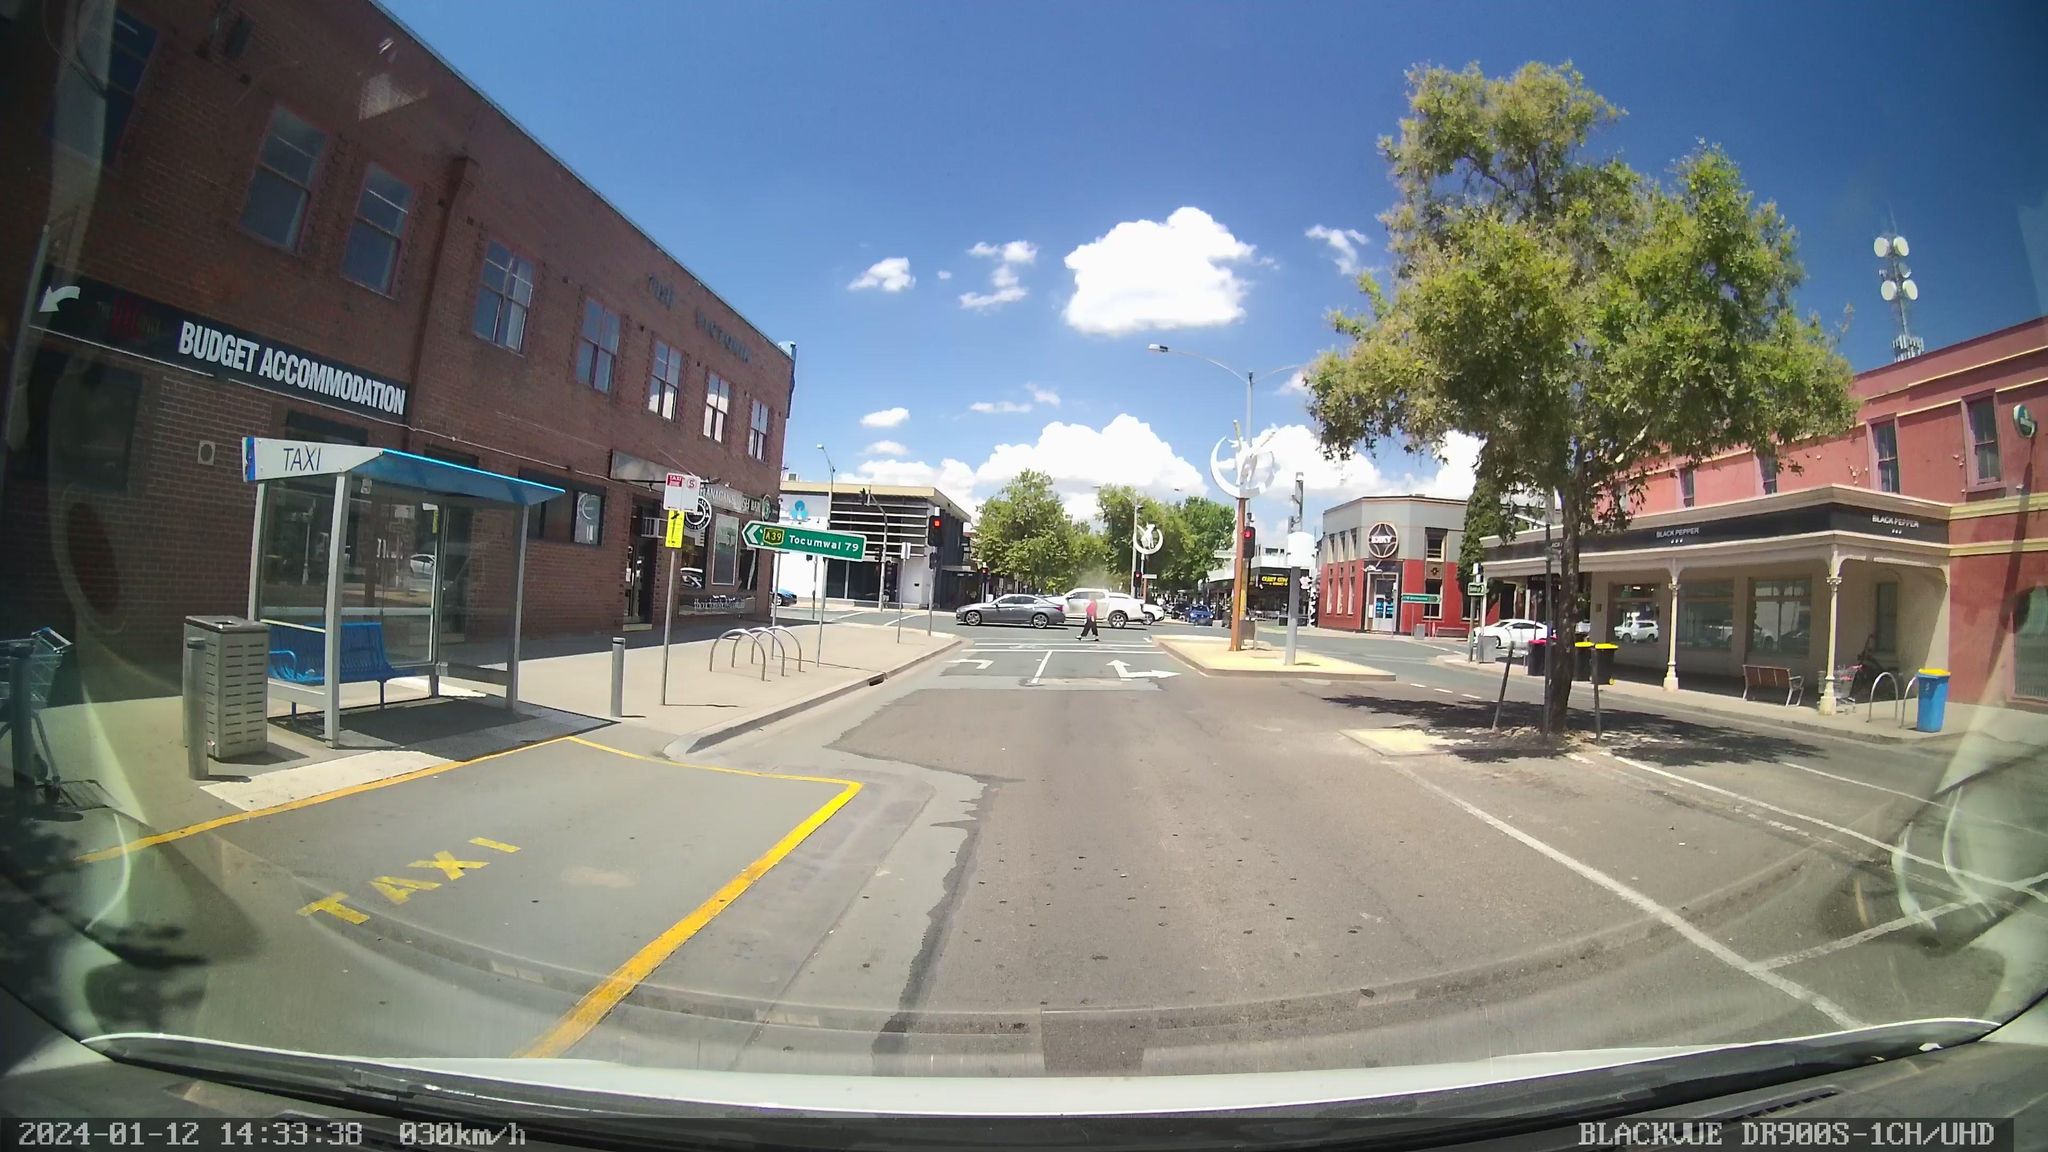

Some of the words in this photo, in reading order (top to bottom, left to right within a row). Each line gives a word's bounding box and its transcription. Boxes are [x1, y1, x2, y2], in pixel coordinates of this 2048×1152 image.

[178, 320, 260, 373] BUDGET
[259, 347, 406, 416] ACCOMMODATION
[283, 447, 322, 472] TAXI
[1872, 514, 1893, 525] BLACK
[1894, 518, 1919, 528] PEPPER
[764, 532, 782, 541] A39
[1656, 529, 1675, 538] BLACK
[1675, 527, 1699, 537] PEPPER
[789, 535, 841, 550] Tocumwal
[844, 542, 859, 552] 79
[295, 837, 522, 925] TAXI
